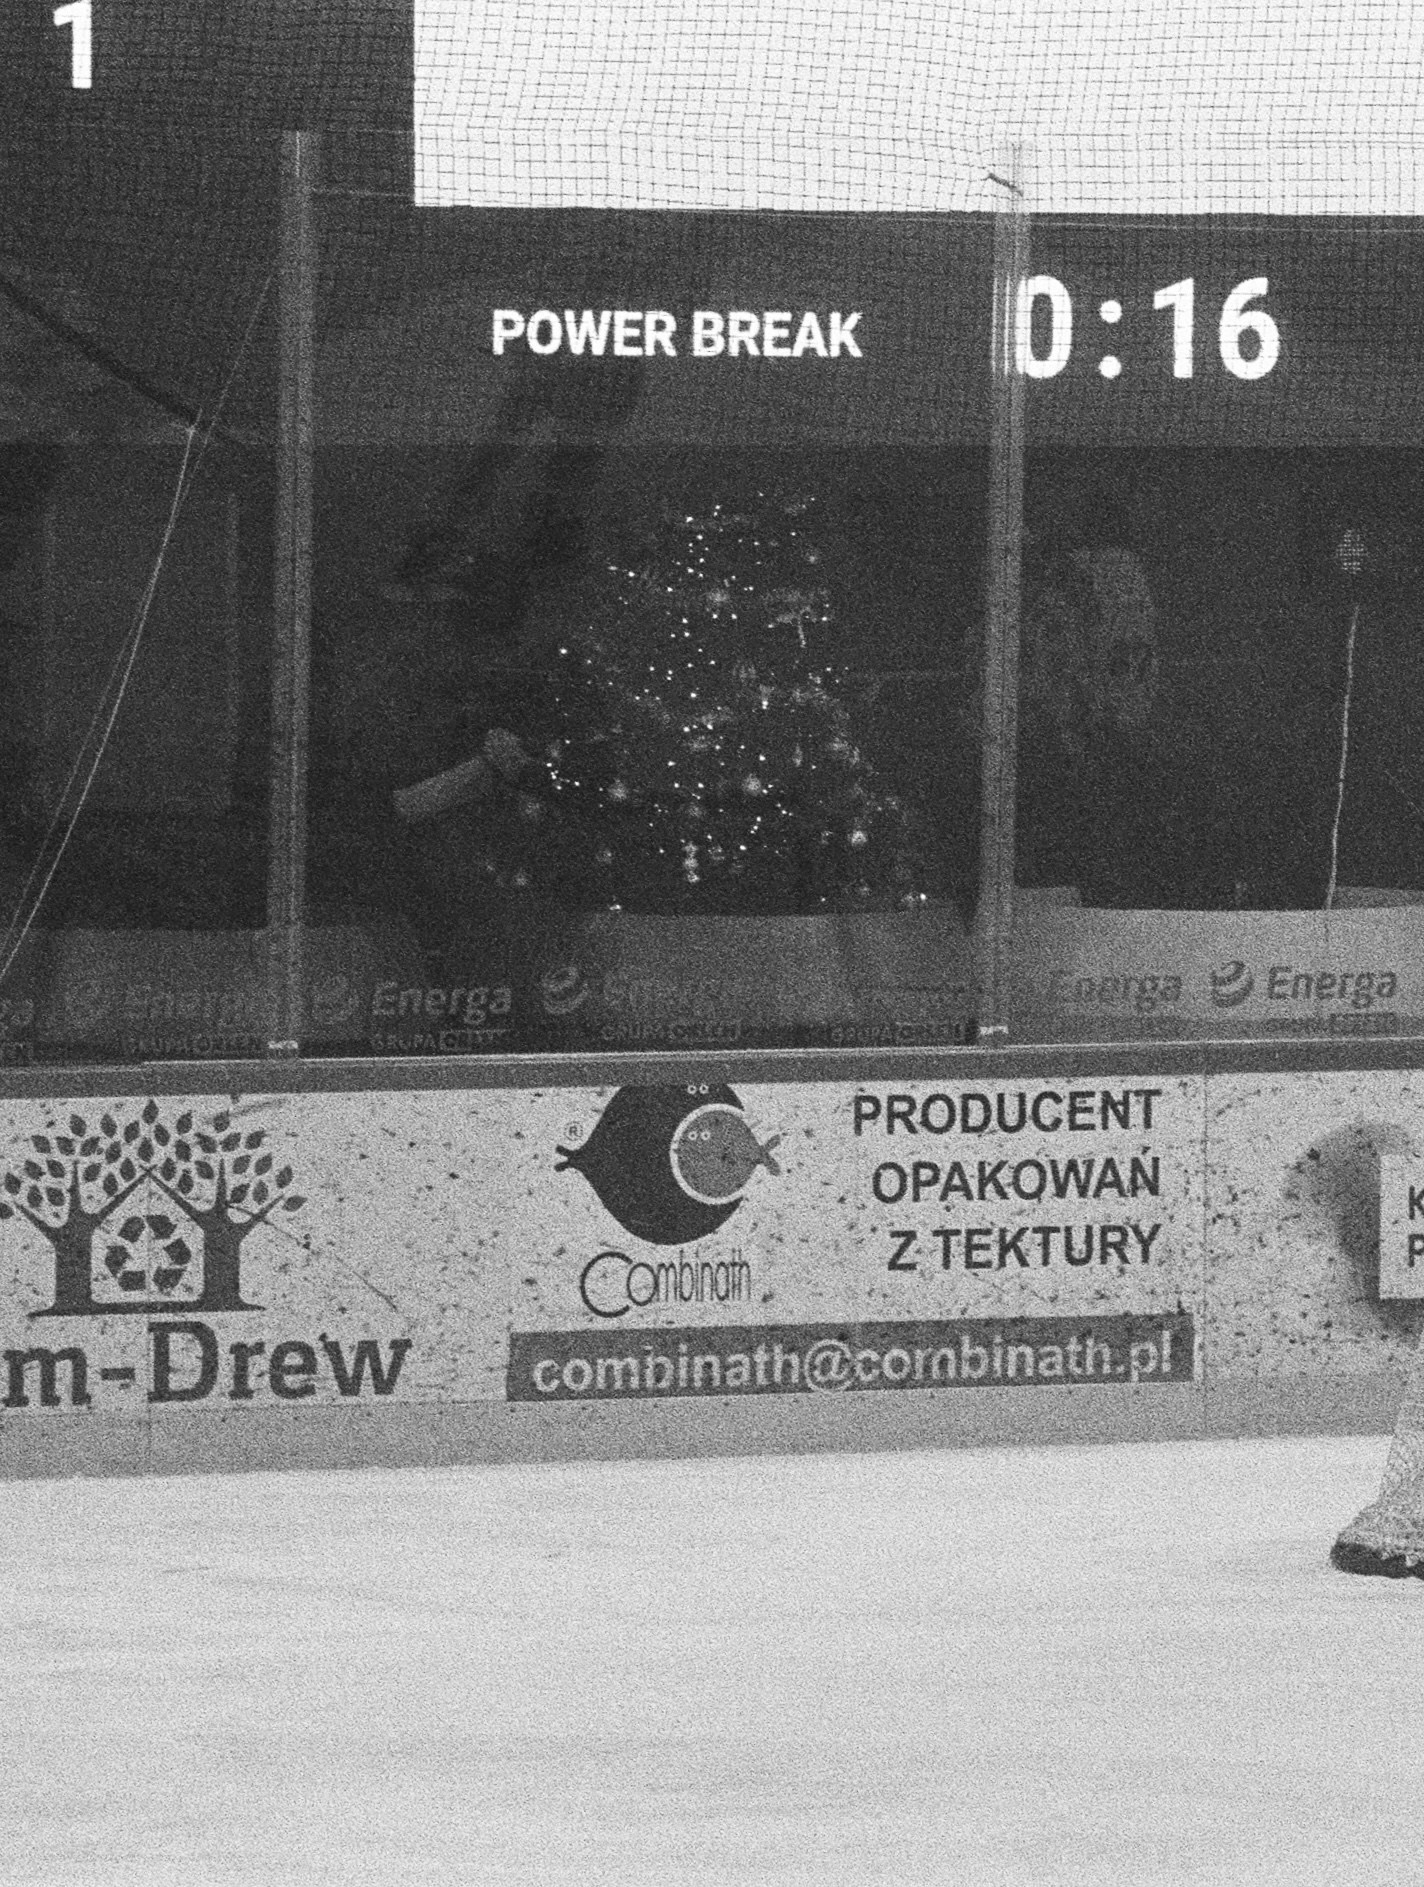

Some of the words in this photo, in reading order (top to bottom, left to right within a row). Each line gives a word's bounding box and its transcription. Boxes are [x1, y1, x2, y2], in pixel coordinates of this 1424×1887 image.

[53, 0, 92, 89] 1
[493, 309, 676, 356] POWER
[693, 310, 863, 357] BREAK
[1013, 274, 1281, 380] 0:16
[371, 980, 512, 1025] Energa
[1048, 969, 1182, 1012] Energa
[1267, 965, 1398, 1008] Energa
[853, 1088, 1162, 1137] PRODUCENT
[872, 1146, 1160, 1204] OPAKOWAŃ
[887, 1229, 918, 1271] Z
[931, 1223, 1162, 1270] TEKTURY
[580, 1249, 750, 1318] Combinath
[532, 1330, 1173, 1394] combinath@combinath.pl
